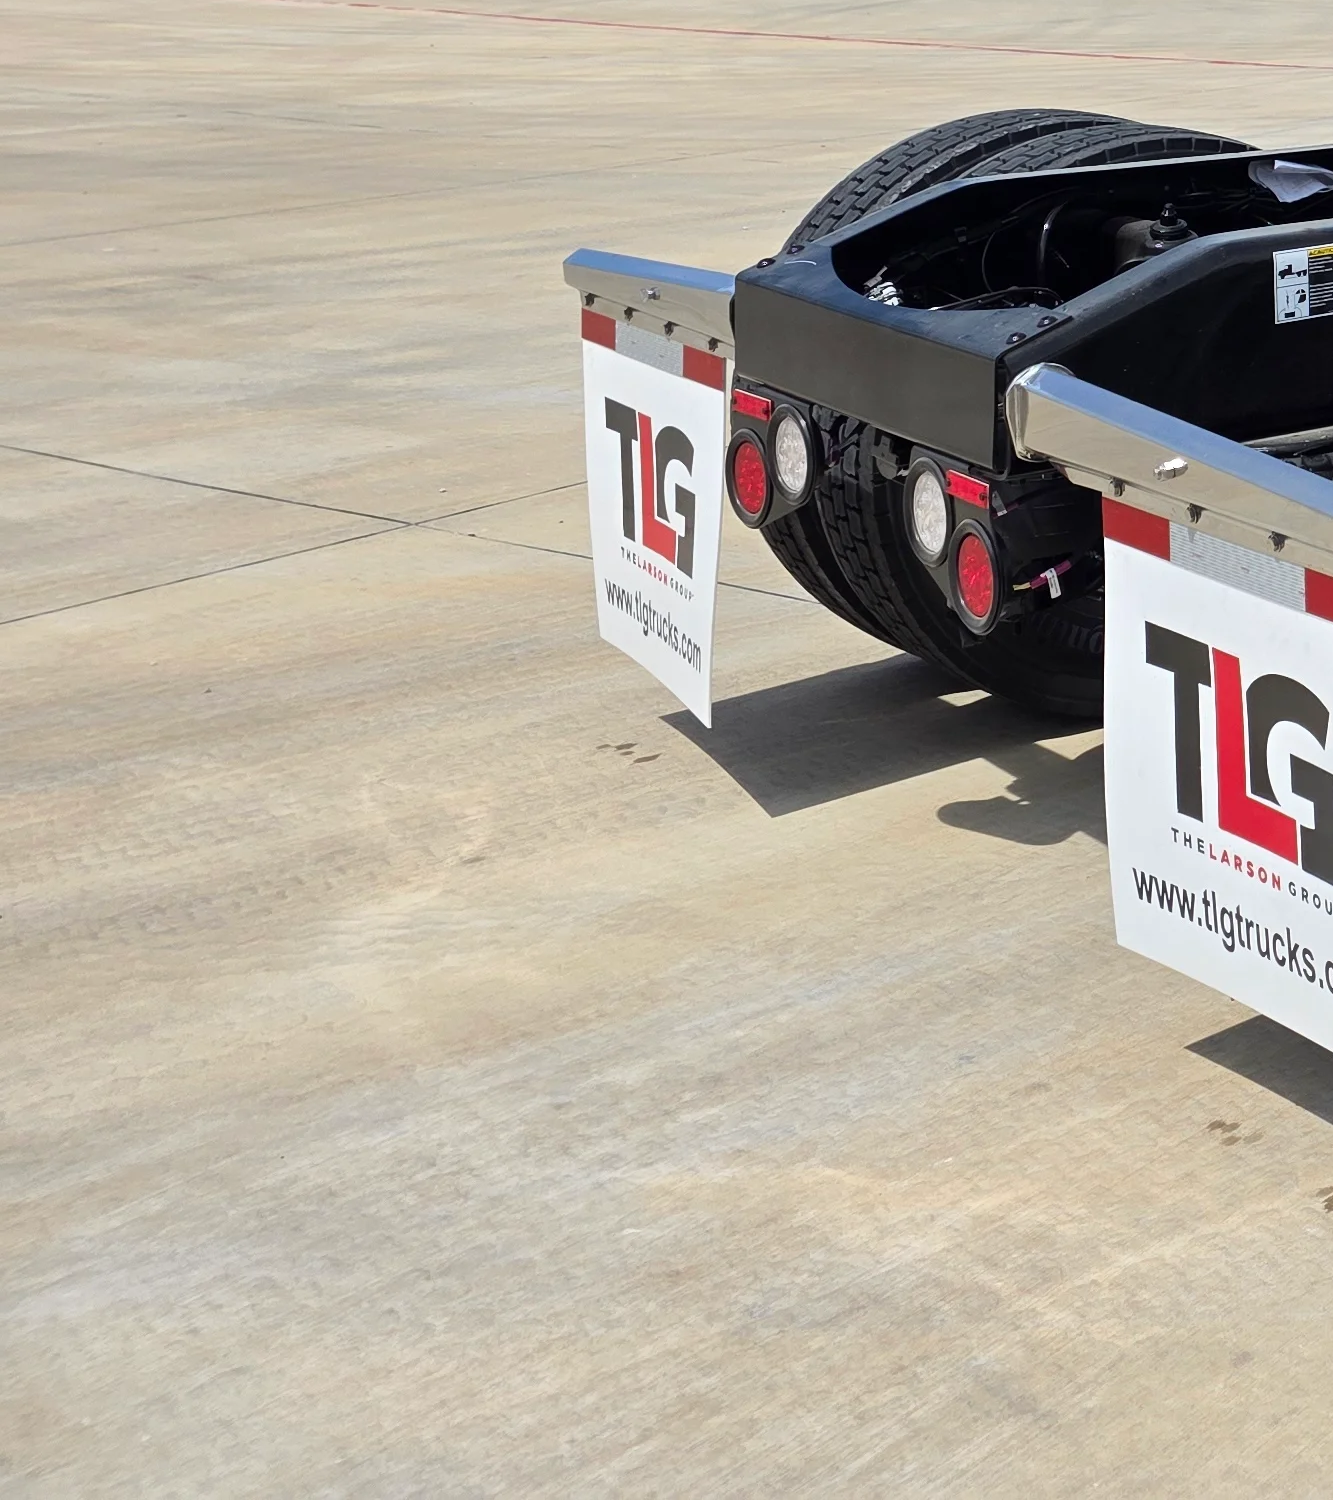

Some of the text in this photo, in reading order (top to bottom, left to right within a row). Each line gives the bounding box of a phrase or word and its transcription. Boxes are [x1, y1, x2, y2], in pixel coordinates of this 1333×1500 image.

[605, 396, 695, 579] TLG
[604, 578, 701, 674] www.tlgtrucks.com
[1170, 826, 1205, 855] THE
[1208, 843, 1282, 892] LARSON
